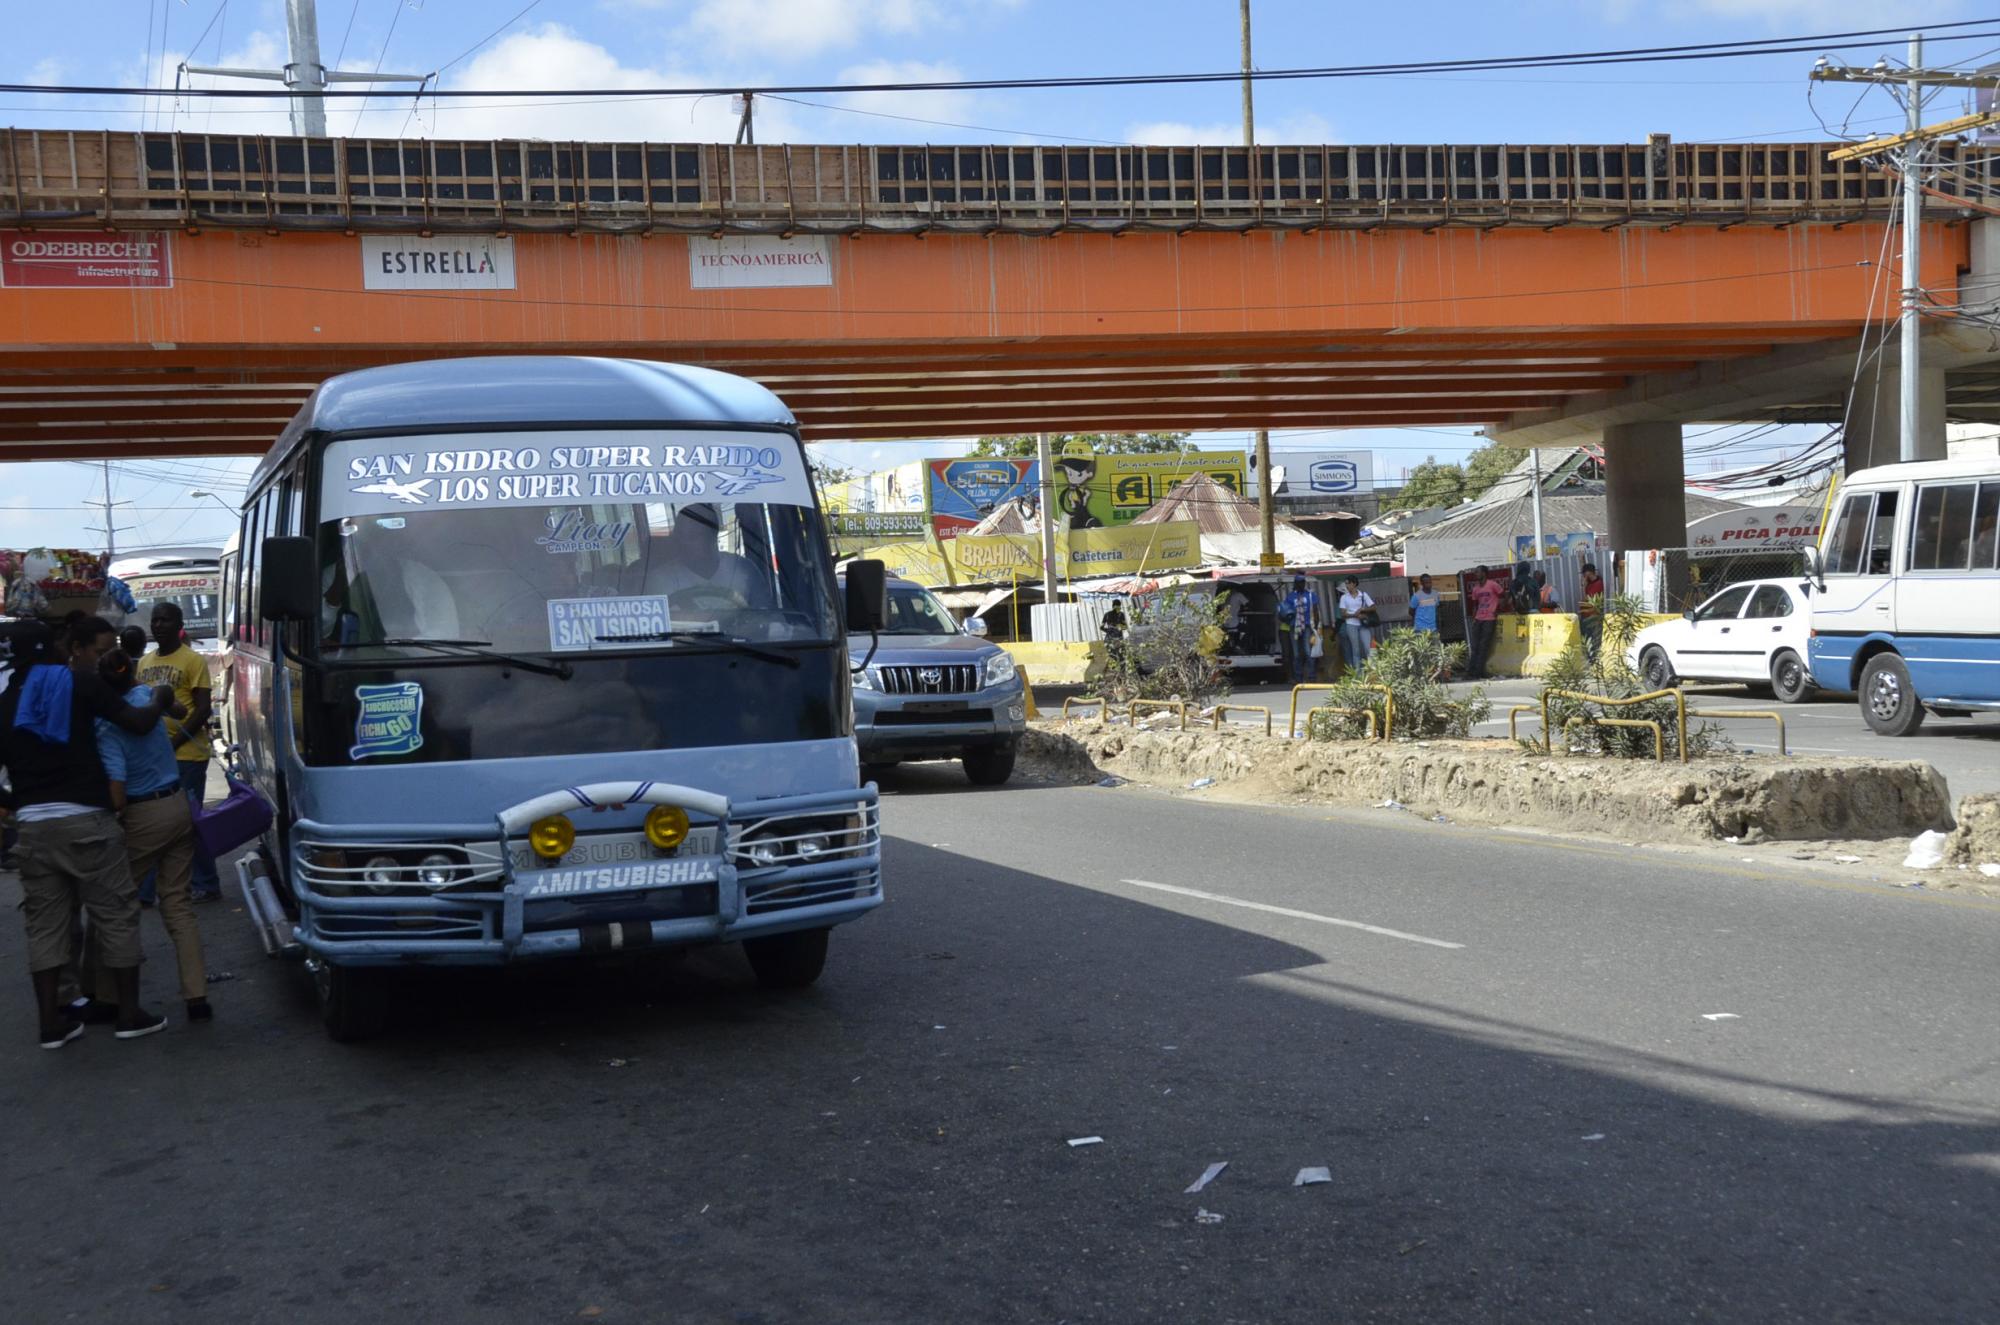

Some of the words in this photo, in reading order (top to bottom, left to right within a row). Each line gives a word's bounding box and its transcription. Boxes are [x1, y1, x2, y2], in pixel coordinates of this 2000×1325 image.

[12, 241, 157, 257] ODEBRECHT
[382, 251, 495, 274] ESTRELLA
[699, 252, 824, 267] TECNOAMERICA
[77, 265, 159, 277] infraestructura
[349, 453, 415, 480] SAN
[424, 448, 541, 474] ISIDRO
[550, 445, 652, 470] SUPER
[661, 445, 781, 469] RAPIDO
[1314, 472, 1352, 480] SIMMONS
[437, 476, 489, 503] LOS
[498, 472, 581, 500] SUPER
[589, 471, 706, 497] TUCANOS
[864, 516, 924, 530] 809-593-3334
[1722, 528, 1770, 541] PICA
[1775, 526, 1826, 538] POLL
[962, 543, 1034, 568] BRAHMA
[1162, 549, 1188, 559] LIGHT
[977, 567, 1012, 579] LIGHT
[143, 578, 208, 590] EXPRESO
[555, 604, 565, 619] 9
[569, 601, 663, 618] HAINAMOSA
[559, 618, 597, 645] SAN
[602, 616, 665, 641] ISIDRO
[360, 723, 388, 738] FICHA
[387, 714, 412, 737] 60
[510, 836, 713, 868] MISUBIHI
[550, 862, 697, 892] MITSUBISHI
